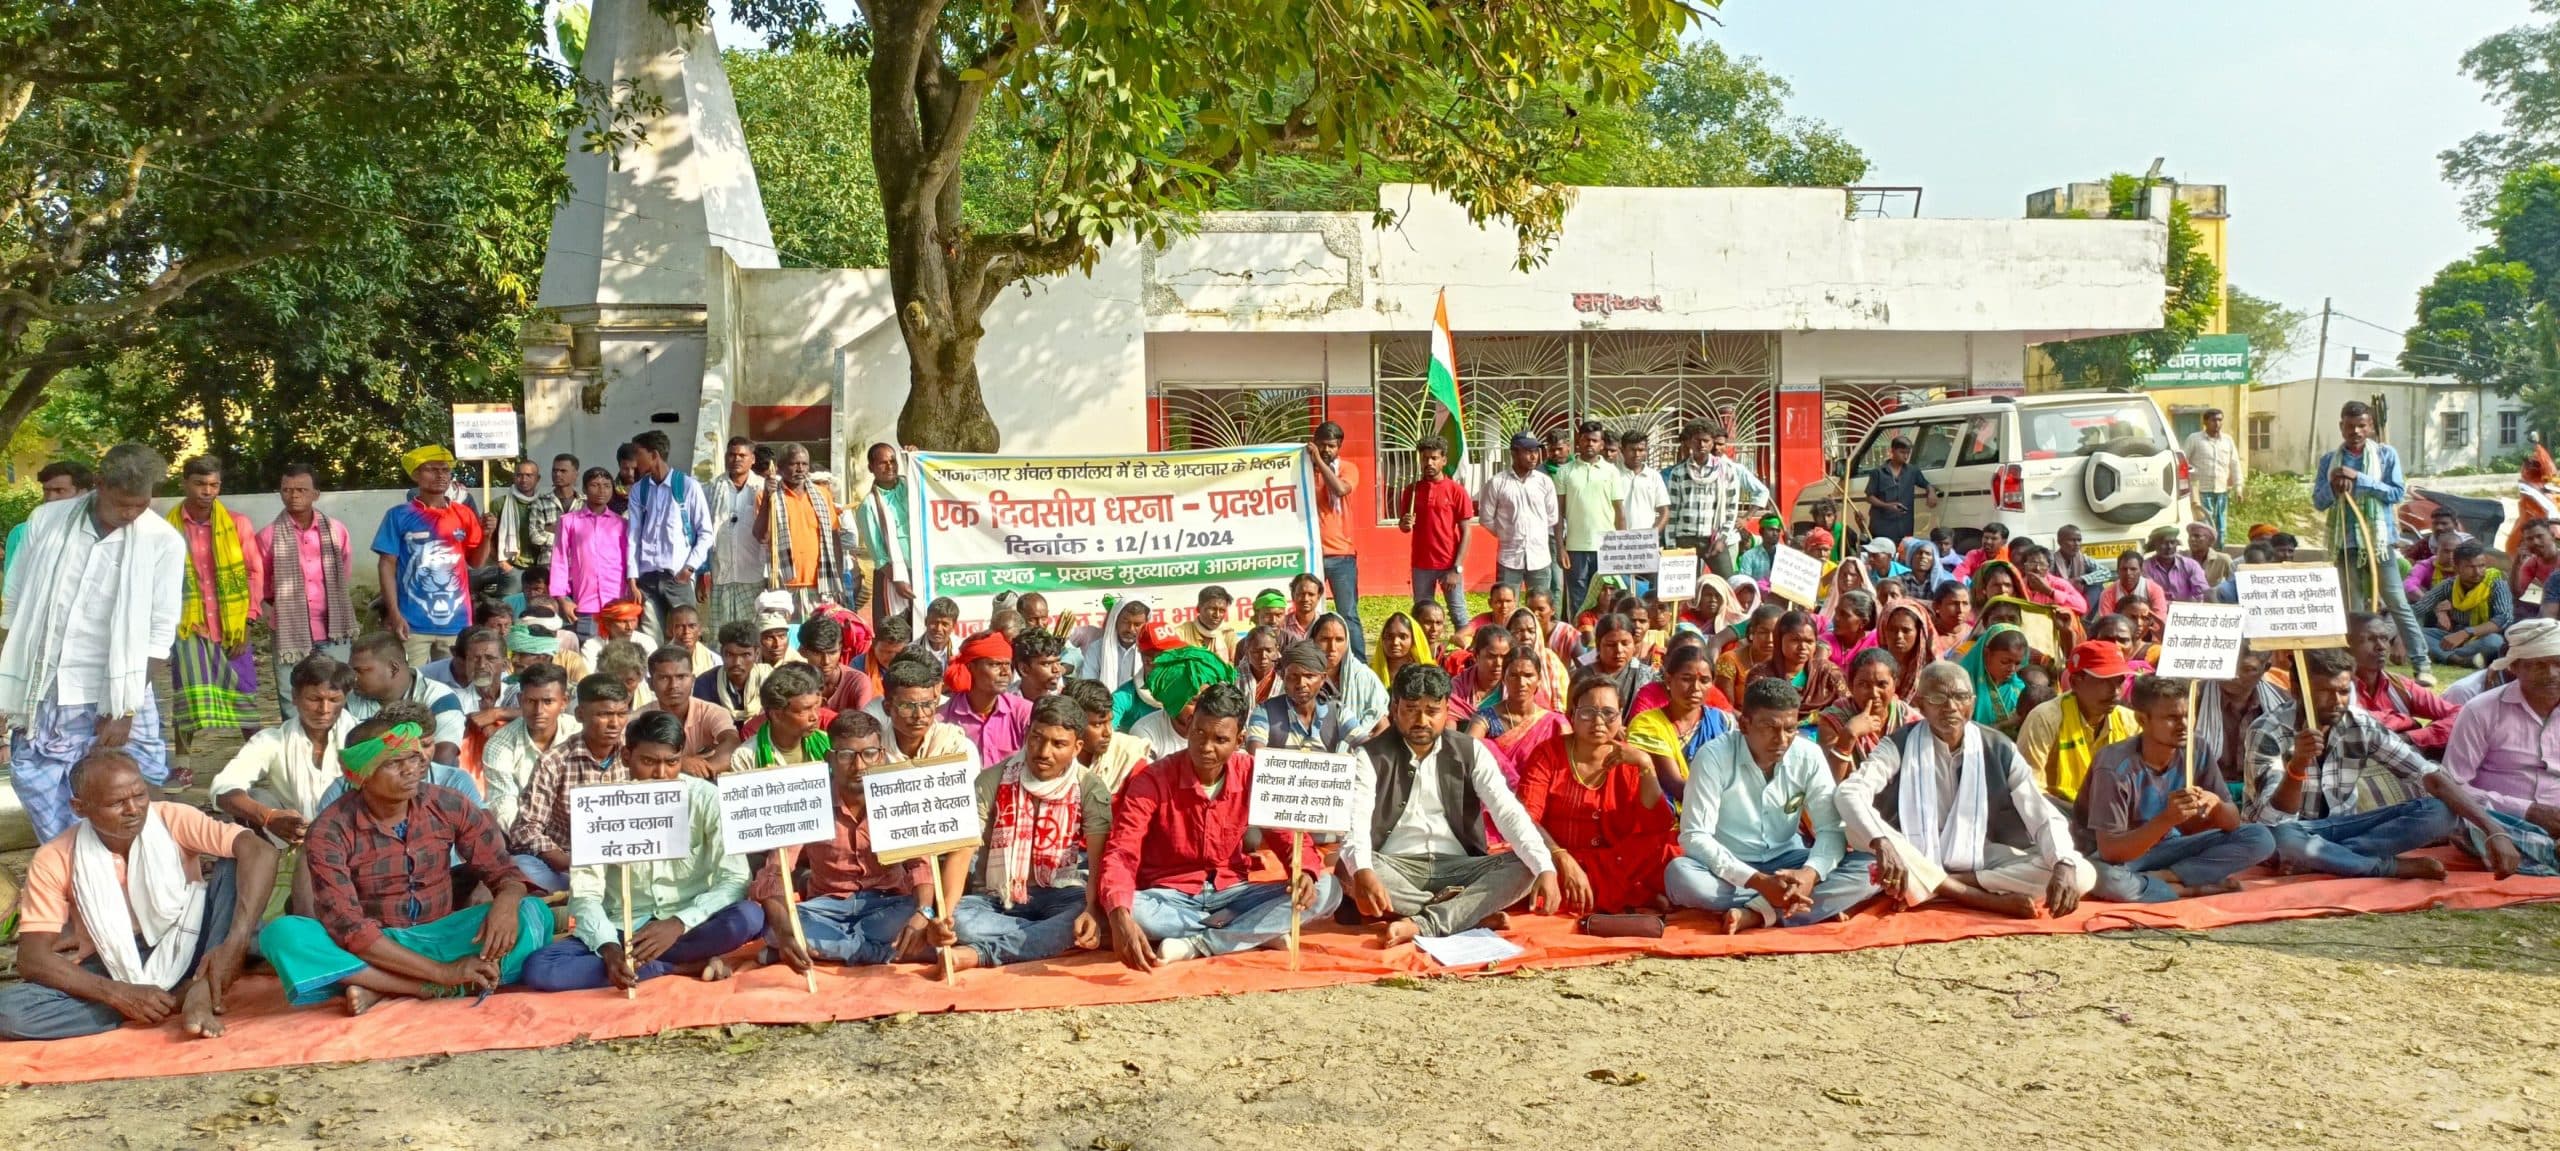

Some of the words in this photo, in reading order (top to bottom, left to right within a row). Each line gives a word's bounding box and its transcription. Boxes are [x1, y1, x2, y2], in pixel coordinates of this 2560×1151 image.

[2202, 353, 2243, 368] भवन
[934, 466, 1011, 482] आजमनगर
[1014, 462, 1053, 482] अंचल
[1116, 461, 1131, 478] में
[1134, 461, 1148, 478] हो
[1151, 460, 1171, 478] रहे
[1174, 462, 1228, 477] भ्रष्टाचार
[1232, 458, 1247, 473] के
[930, 500, 980, 531] एक
[989, 488, 1097, 528] दिवसीय
[1104, 494, 1175, 524] धरना
[1182, 502, 1200, 511] -
[1208, 477, 1297, 522] प्रदर्शन
[1004, 533, 1088, 555] दिनांक
[1096, 538, 1104, 552] :
[1115, 529, 1234, 554] 12/11/2024
[940, 569, 987, 588] धरना
[992, 567, 1036, 585] स्थल
[1056, 566, 1115, 584] प्रखण्ड
[1118, 560, 1200, 585] मुख्यालय
[1204, 552, 1300, 575] आजमनगर
[2250, 574, 2274, 585] बिहार
[2276, 574, 2308, 584] सरकार
[2309, 572, 2322, 583] कि
[2241, 589, 2268, 601] जमीन
[2270, 588, 2279, 599] में
[2249, 605, 2262, 616] को
[2264, 606, 2284, 616] लाल
[2171, 612, 2209, 628] सिकमीदार
[2210, 613, 2219, 628] के
[2270, 621, 2298, 631] कराया
[2299, 621, 2318, 631] जाए
[2167, 634, 2179, 648] को
[2180, 634, 2203, 649] जमीन
[2203, 635, 2211, 649] से
[2173, 658, 2196, 669] करना
[2209, 657, 2223, 670] करो
[1264, 755, 1287, 769] अंचल
[1288, 758, 1330, 773] पदाधिकारी
[1331, 762, 1348, 774] द्वारा
[870, 779, 922, 798] सिकमीदार
[923, 774, 935, 789] के
[937, 768, 968, 787] वंशजों
[1256, 773, 1285, 787] मोटेशन
[1287, 774, 1297, 787] में
[1297, 775, 1319, 789] अंचल
[1320, 778, 1352, 790] कर्मचारी
[722, 785, 750, 802] गरीबों
[751, 784, 764, 798] को
[766, 781, 786, 797] मिले
[1260, 791, 1270, 802] के
[1272, 793, 1299, 805] माध्यम
[1300, 794, 1309, 806] से
[1333, 795, 1344, 808] कि
[577, 789, 650, 813] भू-माफिया
[654, 790, 682, 806] द्वारा
[730, 806, 758, 821] जमीन
[759, 806, 771, 817] पर
[773, 797, 807, 815] पर्चाधारी
[809, 796, 822, 810] को
[873, 804, 888, 821] को
[890, 801, 920, 818] जमीन
[922, 798, 932, 813] से
[934, 795, 970, 811] बेदखल
[586, 815, 627, 834] अंचल
[628, 815, 674, 831] चलाना
[1274, 809, 1292, 822] मांग
[1294, 810, 1306, 823] बंद
[765, 822, 796, 837] दिलाया
[890, 825, 919, 841] करना
[920, 820, 937, 836] बंद
[938, 817, 960, 834] करो
[601, 840, 623, 857] बंद
